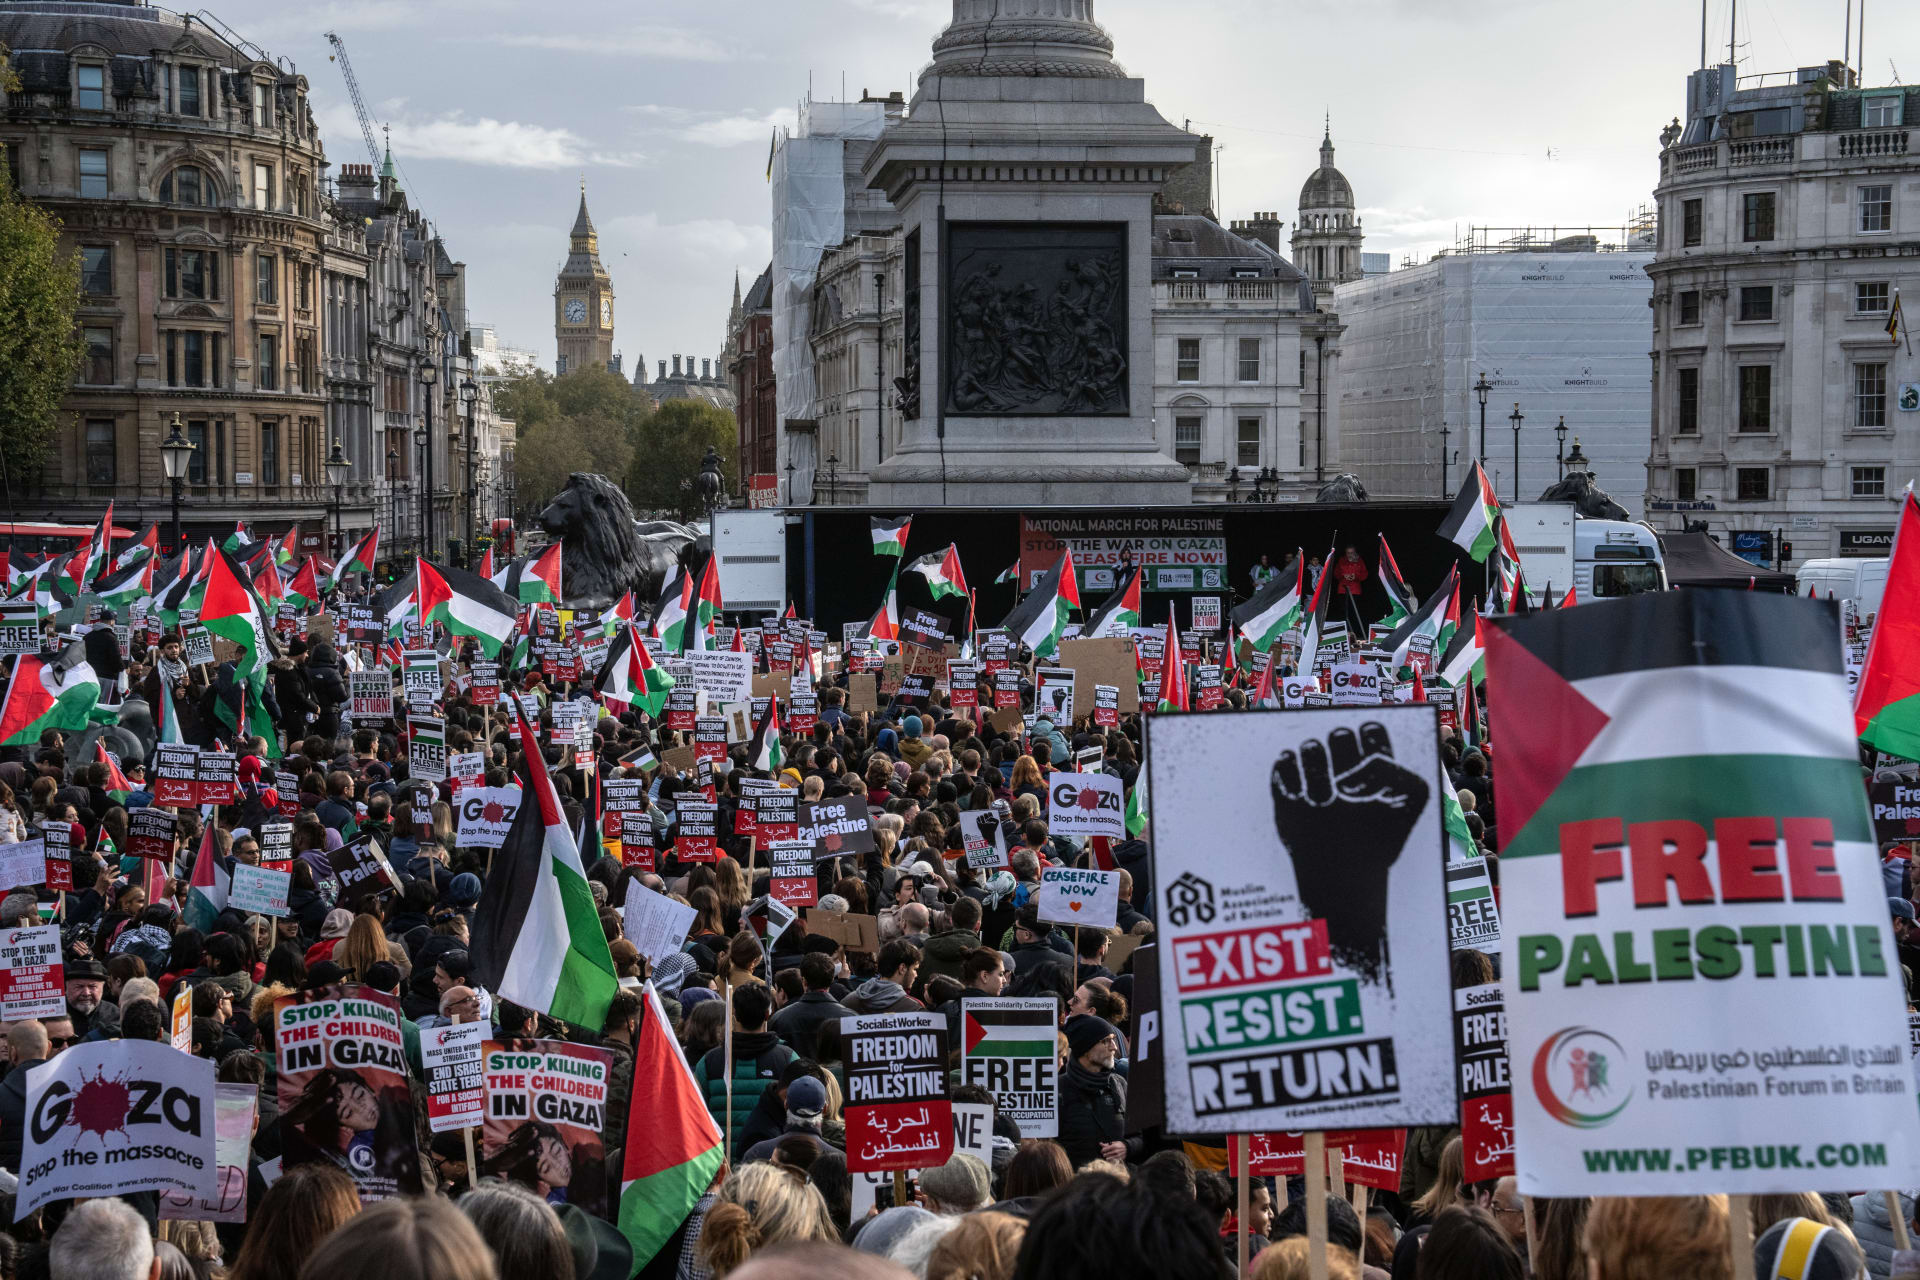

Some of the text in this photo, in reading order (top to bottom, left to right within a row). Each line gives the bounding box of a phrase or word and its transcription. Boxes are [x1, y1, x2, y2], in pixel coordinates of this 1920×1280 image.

[1025, 519, 1223, 531] NATIONAL MARCH FOR PALESTINE
[1025, 539, 1223, 551] STOP THE WAR ON GAZA!
[1852, 535, 1893, 544] UGAN
[1174, 553, 1223, 564] NOW!
[352, 608, 373, 619] Free
[917, 612, 938, 627] Free
[1194, 617, 1219, 627] RETURN!
[0, 627, 38, 641] FREE
[902, 619, 944, 640] Palestine
[0, 640, 39, 650] PALESTINE
[185, 637, 211, 654] FREE
[823, 655, 842, 664] Palestine
[473, 669, 496, 679] FREEDOM
[904, 664, 932, 675] EVERY
[954, 672, 976, 680] FREEDOM
[353, 672, 390, 682] FREE PALESTINE
[404, 671, 438, 685] FREE
[904, 677, 923, 687] Free
[997, 674, 1018, 682] FREEDOM
[353, 682, 391, 691] EXIST!
[472, 679, 498, 691] PALESTINE
[952, 681, 976, 690] PALESTINE
[996, 683, 1019, 691] PALESTINE
[354, 690, 391, 699] RESIST!
[672, 692, 694, 701] FREEDOM
[1097, 690, 1118, 699] FREEDOM
[354, 699, 391, 713] RETURN!
[671, 702, 694, 711] PALESTINE
[793, 698, 815, 706] FREEDOM
[1095, 699, 1118, 709] PALESTINE
[792, 706, 816, 715] PALESTINE
[698, 723, 725, 732] FREEDOM
[696, 733, 726, 742] PALESTINE
[160, 752, 195, 765] FREEDOM
[410, 744, 444, 763] FREE
[200, 759, 232, 771] FREEDOM
[410, 759, 445, 771] PALESTINE
[158, 769, 196, 783] PALESTINE
[198, 771, 233, 784] PALESTINE
[163, 782, 189, 794] الحرية
[204, 783, 227, 794] الحرية
[277, 779, 298, 792] FREEDOM
[607, 787, 638, 797] FREEDOM
[160, 792, 192, 803] لفلسطين
[201, 792, 230, 802] لفلسطين
[277, 789, 300, 804] PALESTINE
[760, 797, 794, 808] FREEDOM
[1053, 783, 1120, 812] Gza
[606, 800, 641, 811] PALESTINE
[681, 811, 713, 822] FREEDOM
[758, 811, 796, 823] PALESTINE
[810, 804, 846, 823] Free
[1053, 814, 1087, 824] Stop the
[132, 812, 172, 831] FREEDOM
[624, 821, 651, 834] FREEDOM
[129, 825, 173, 843] PALESTINE
[461, 827, 491, 837] Stop the
[680, 825, 715, 836] PALESTINE
[798, 818, 868, 841] Palestine
[263, 833, 291, 848] FREEDOM
[622, 834, 653, 848] PALESTINE
[686, 839, 709, 849] الحرية
[966, 839, 989, 850] EXIST.
[261, 848, 292, 864] PALESTINE
[627, 847, 649, 858] الحرية
[683, 848, 712, 858] لفلسطين
[774, 849, 812, 861] FREEDOM
[969, 856, 1001, 867] RETURN.
[1560, 815, 1846, 920] FREE
[772, 864, 814, 877] PALESTINE
[1043, 871, 1109, 886] CEASEFIRE
[780, 880, 808, 892] الحرية
[1060, 884, 1098, 897] NOW
[1220, 884, 1266, 899] Muslim
[776, 890, 812, 902] لفلسطين
[1221, 892, 1295, 911] Association
[1224, 907, 1284, 923] of Britain
[1448, 897, 1497, 929] REE
[2, 943, 56, 958] STOP THE WAR
[1173, 926, 1329, 988] EXIST.
[12, 954, 47, 968] ON GAZA!
[1518, 924, 1889, 993] PALESTINE
[966, 1001, 1054, 1010] Palestine Solidarity Campaign
[282, 1002, 396, 1026] STOP KILLING
[1180, 986, 1362, 1050] RESIST.
[281, 1021, 401, 1046] THE CHILDREN
[446, 1027, 478, 1038] Socialist
[426, 1045, 462, 1059] MASS UNITED
[851, 1034, 938, 1063] FREEDOM
[286, 1039, 404, 1072] IN GAZA
[442, 1052, 468, 1063] STRUGGLE
[1645, 1044, 1901, 1074] المنتدى الفلسطيني في بريطانيا
[433, 1065, 452, 1081] END
[490, 1054, 603, 1081] STOP KILLING
[887, 1060, 904, 1073] for
[965, 1057, 1055, 1093] FREE
[1189, 1044, 1397, 1112] RETURN.
[429, 1078, 459, 1095] STATE
[487, 1074, 605, 1101] THE CHILDREN
[849, 1070, 945, 1102] PALESTINE
[1648, 1073, 1905, 1099] Palestinian Forum in Britain
[437, 1094, 450, 1105] FOR
[31, 1080, 201, 1145] Gza
[451, 1102, 482, 1114] INTIFADA
[492, 1092, 601, 1129] IN GAZA
[866, 1106, 930, 1133] الحرية
[1010, 1110, 1054, 1120] OCCUPATION
[861, 1131, 941, 1161] لفلسطين
[1583, 1141, 1888, 1174] WWW.PFBUK.COM
[26, 1143, 204, 1187] Stop the massacre
[52, 1175, 198, 1194] War Coalition www.stopwar.org.uk
